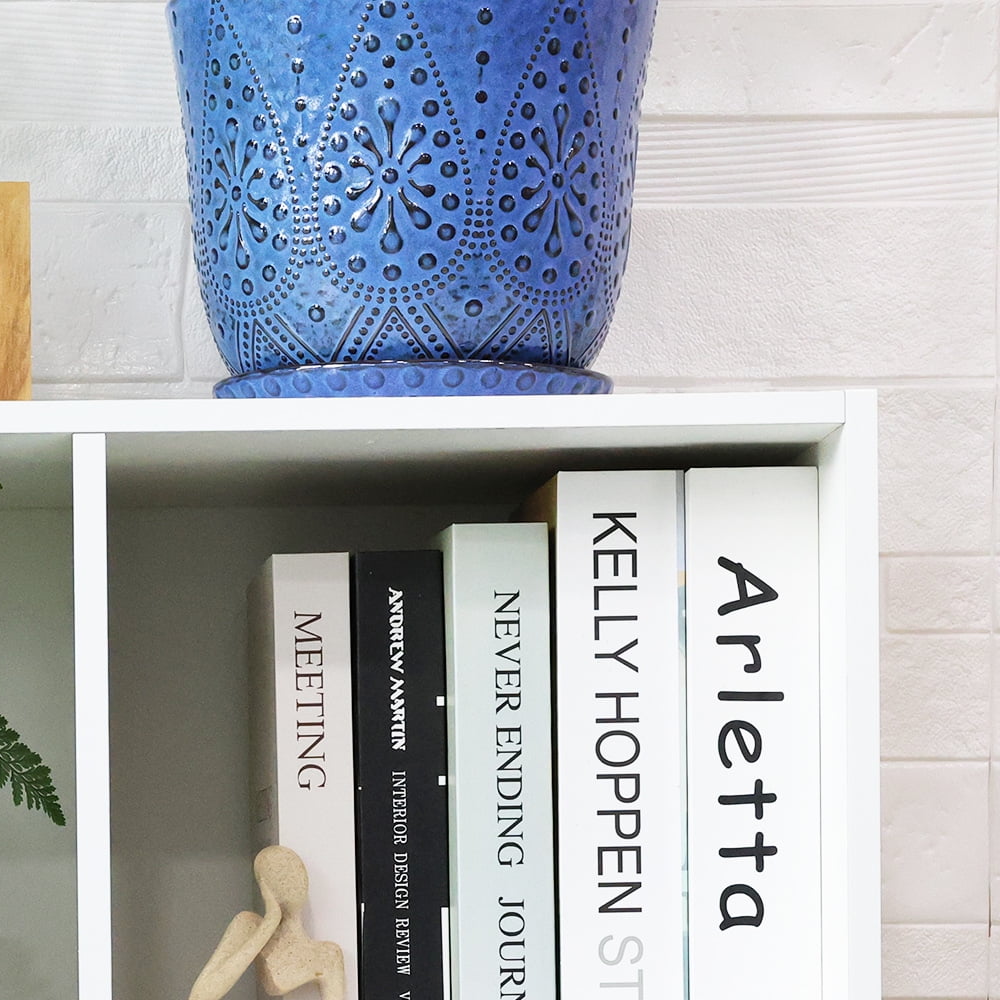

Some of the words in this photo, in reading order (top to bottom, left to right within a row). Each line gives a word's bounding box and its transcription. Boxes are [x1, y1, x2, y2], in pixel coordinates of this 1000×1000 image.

[388, 586, 404, 674] ANDREW
[493, 589, 522, 714] NEVER
[592, 511, 639, 673] KELLY
[293, 610, 327, 791] MEETING
[389, 676, 406, 751] MARTIN
[715, 555, 785, 932] Arletta
[391, 770, 408, 845] INTERIOR
[495, 724, 525, 868] ENDING
[594, 691, 643, 914] HOPPEN
[393, 852, 409, 910] DESIGN
[395, 917, 411, 976] REVIEW
